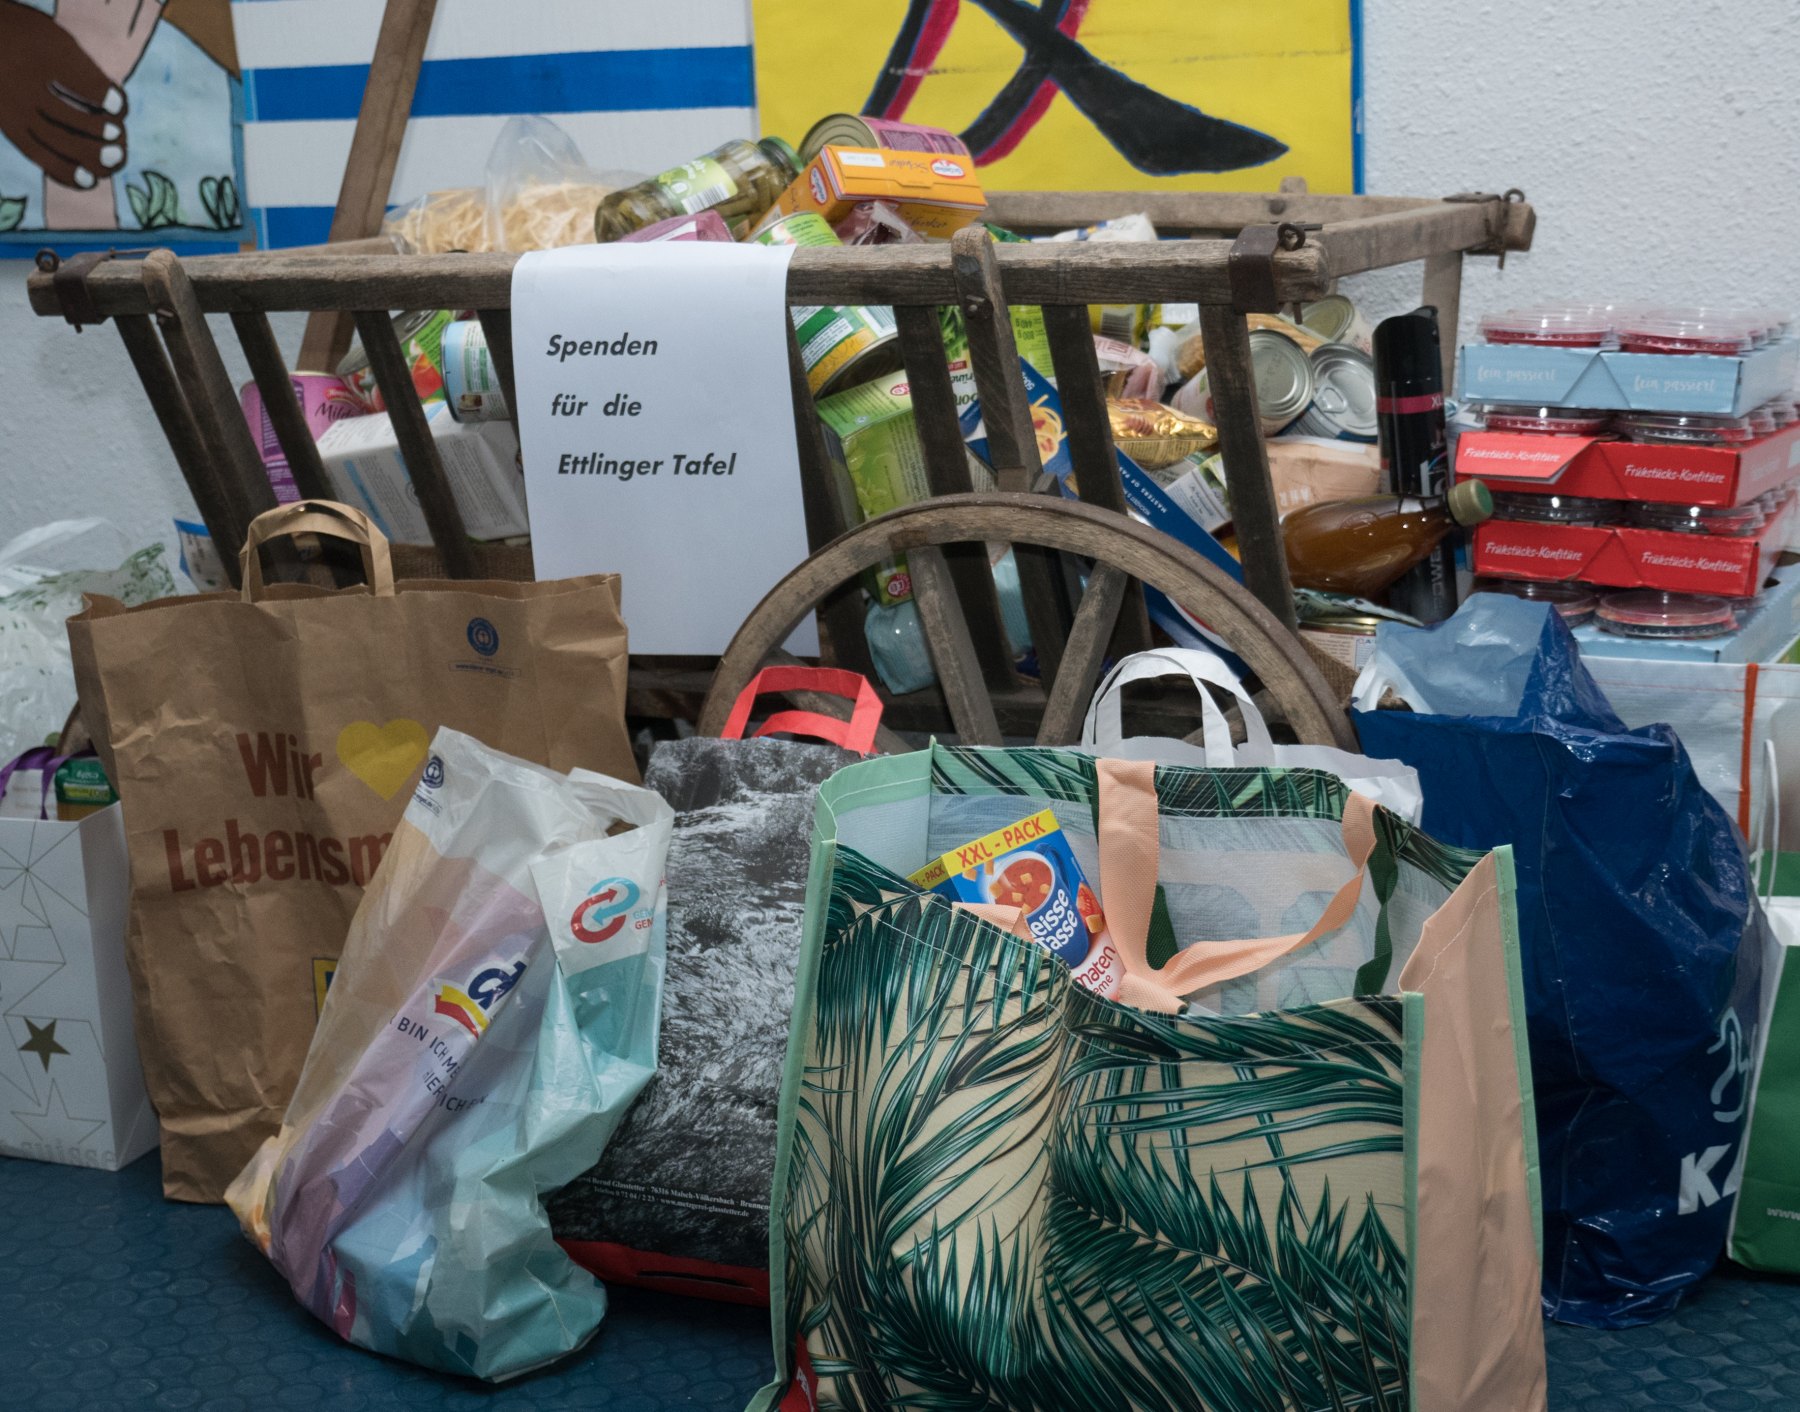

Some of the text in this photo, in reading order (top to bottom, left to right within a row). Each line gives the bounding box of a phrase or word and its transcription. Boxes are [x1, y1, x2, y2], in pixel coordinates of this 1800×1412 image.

[546, 332, 658, 363] Spenden
[1635, 375, 1659, 392] fein
[551, 393, 642, 416] für die
[558, 452, 737, 482] Ettlinger Tafel
[1625, 464, 1727, 484] Frühstücks-Konfitüre
[1485, 541, 1583, 562] Frühstücks-Konfitüre
[1641, 551, 1743, 574] Frühstücks-Konfitüre
[235, 731, 323, 801] Wir
[163, 818, 394, 893] Lebensm
[956, 841, 993, 868] XXL
[1002, 817, 1046, 848] PACK
[1030, 888, 1069, 938] eisse
[1075, 946, 1116, 987] maten
[397, 1016, 429, 1042] BIN
